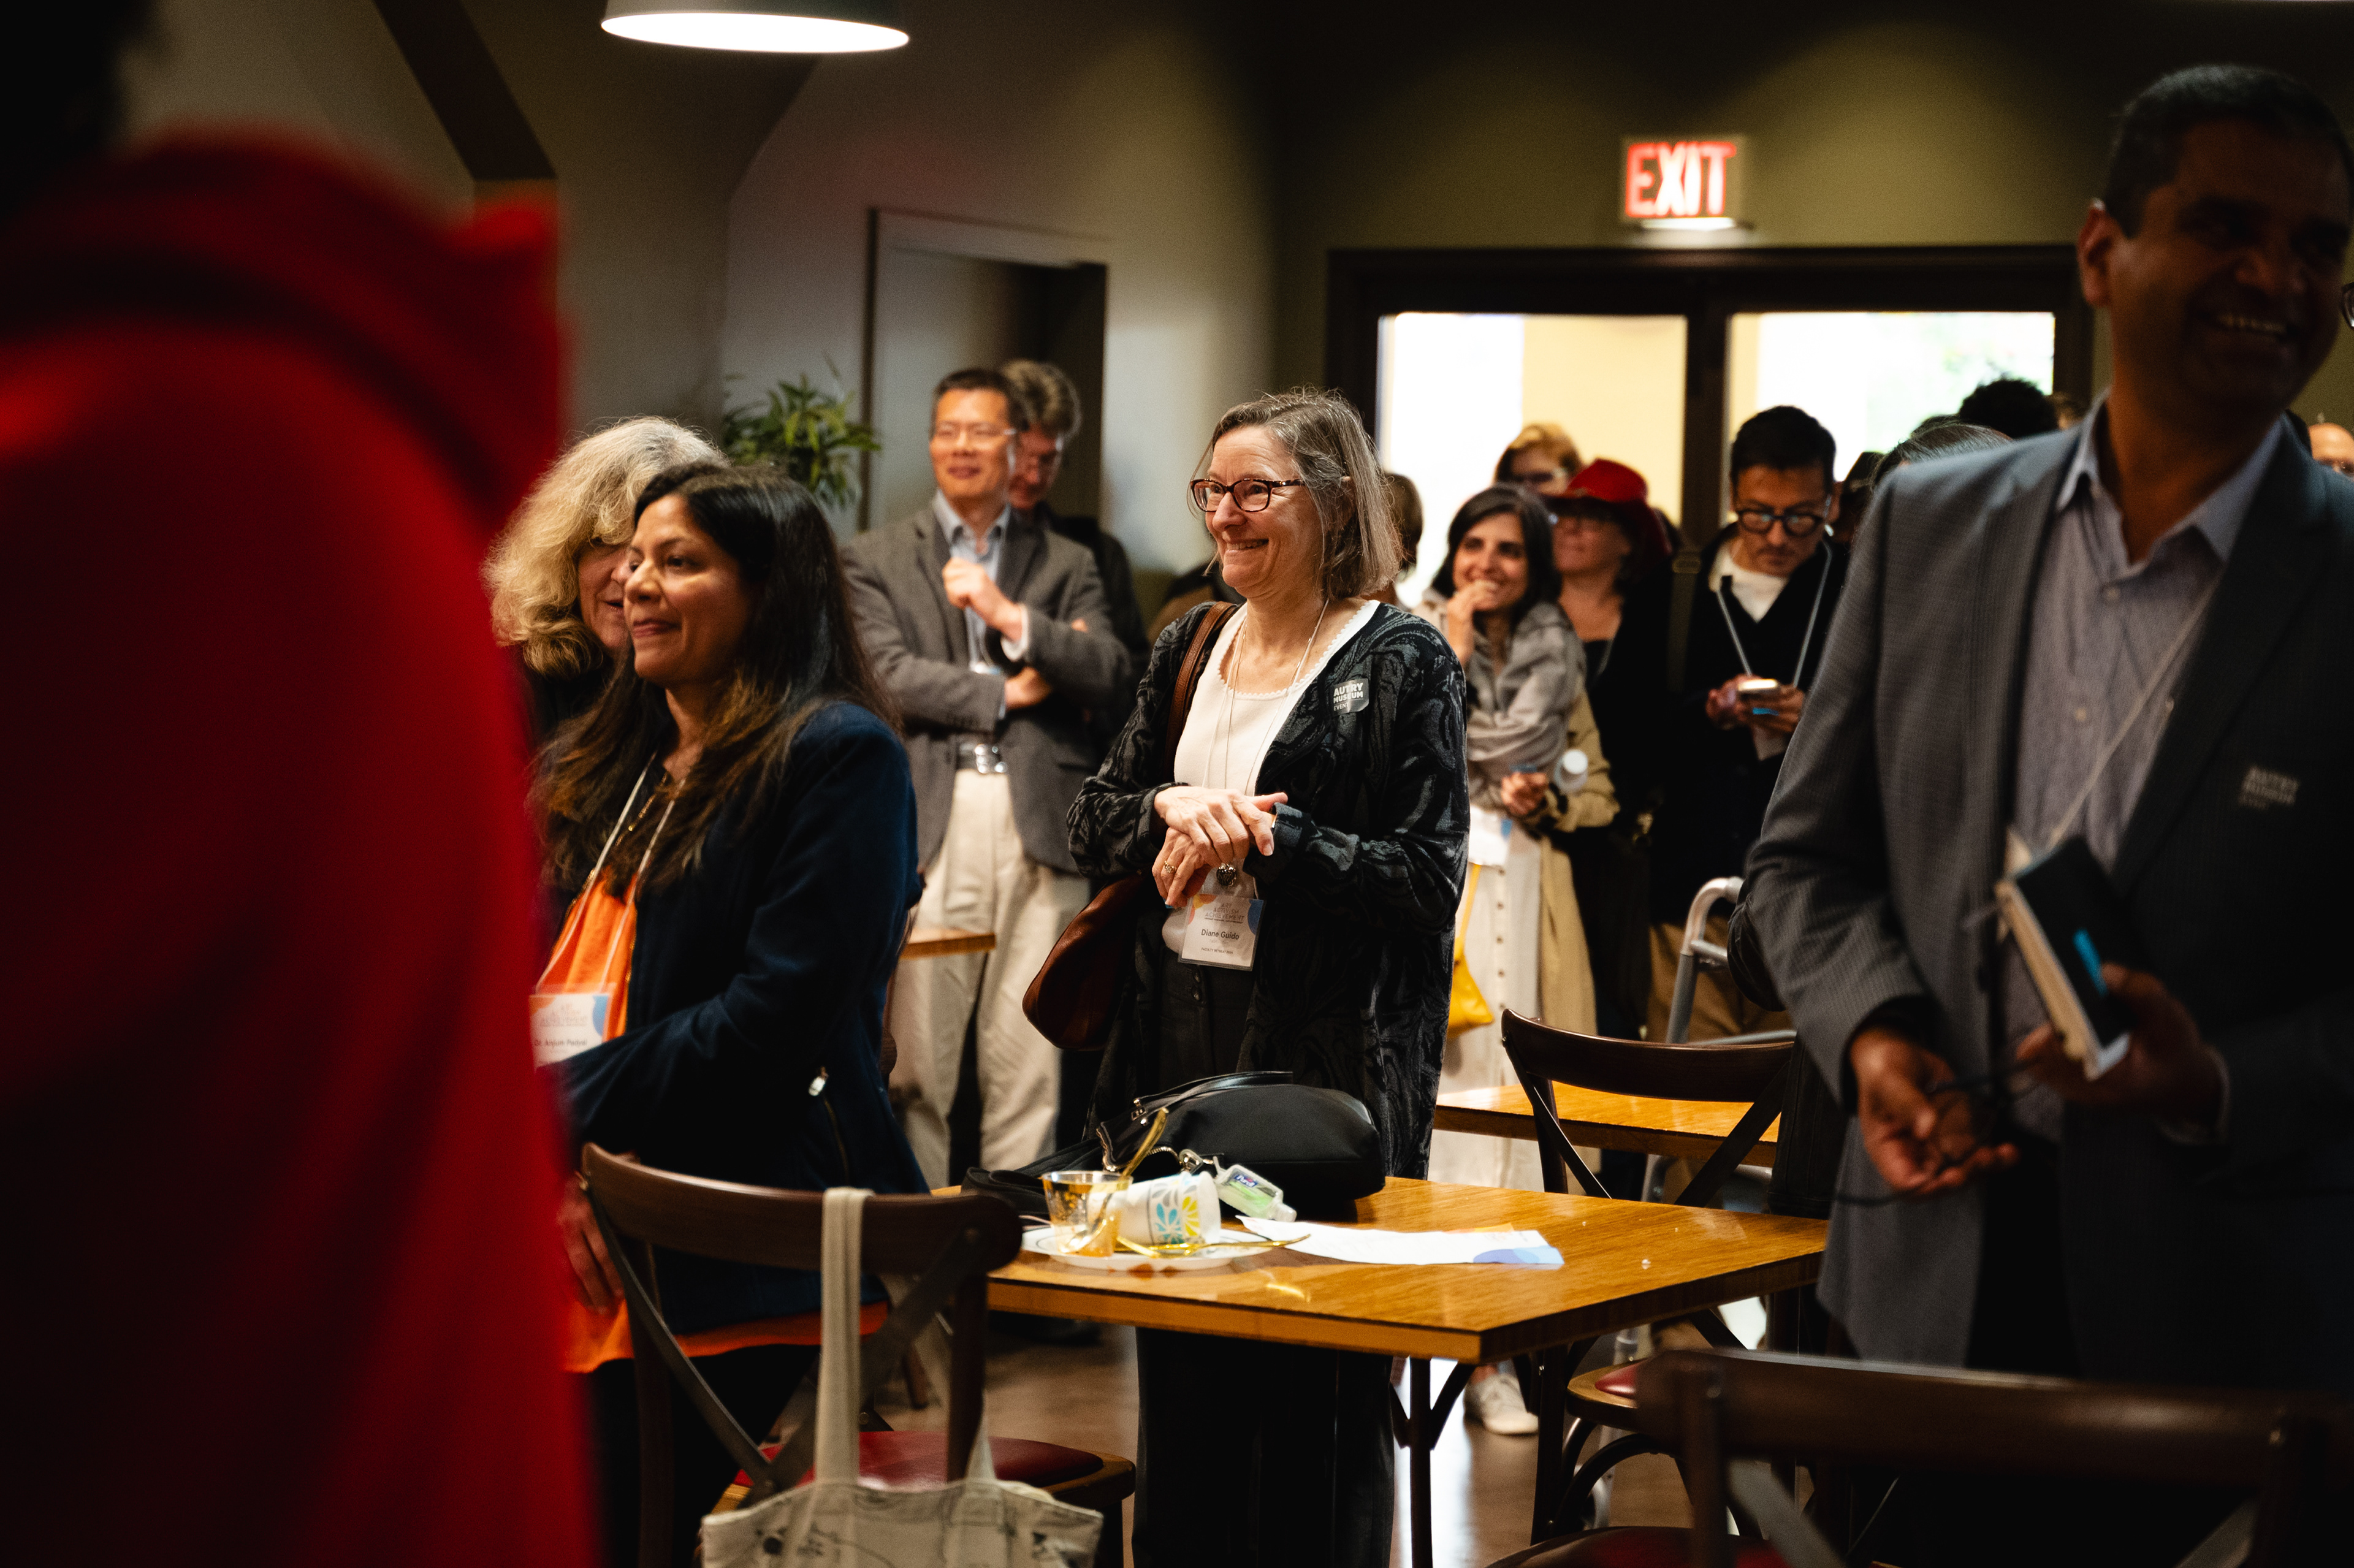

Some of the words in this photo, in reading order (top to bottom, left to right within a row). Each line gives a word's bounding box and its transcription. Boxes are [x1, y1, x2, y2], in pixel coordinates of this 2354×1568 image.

[1625, 141, 1737, 218] EXIT
[1333, 682, 1363, 697] AUTRY
[1333, 691, 1363, 704] MUSEUM
[1333, 702, 1349, 711] EVENT
[1201, 929, 1219, 937] Diane
[1221, 931, 1240, 940] Guido
